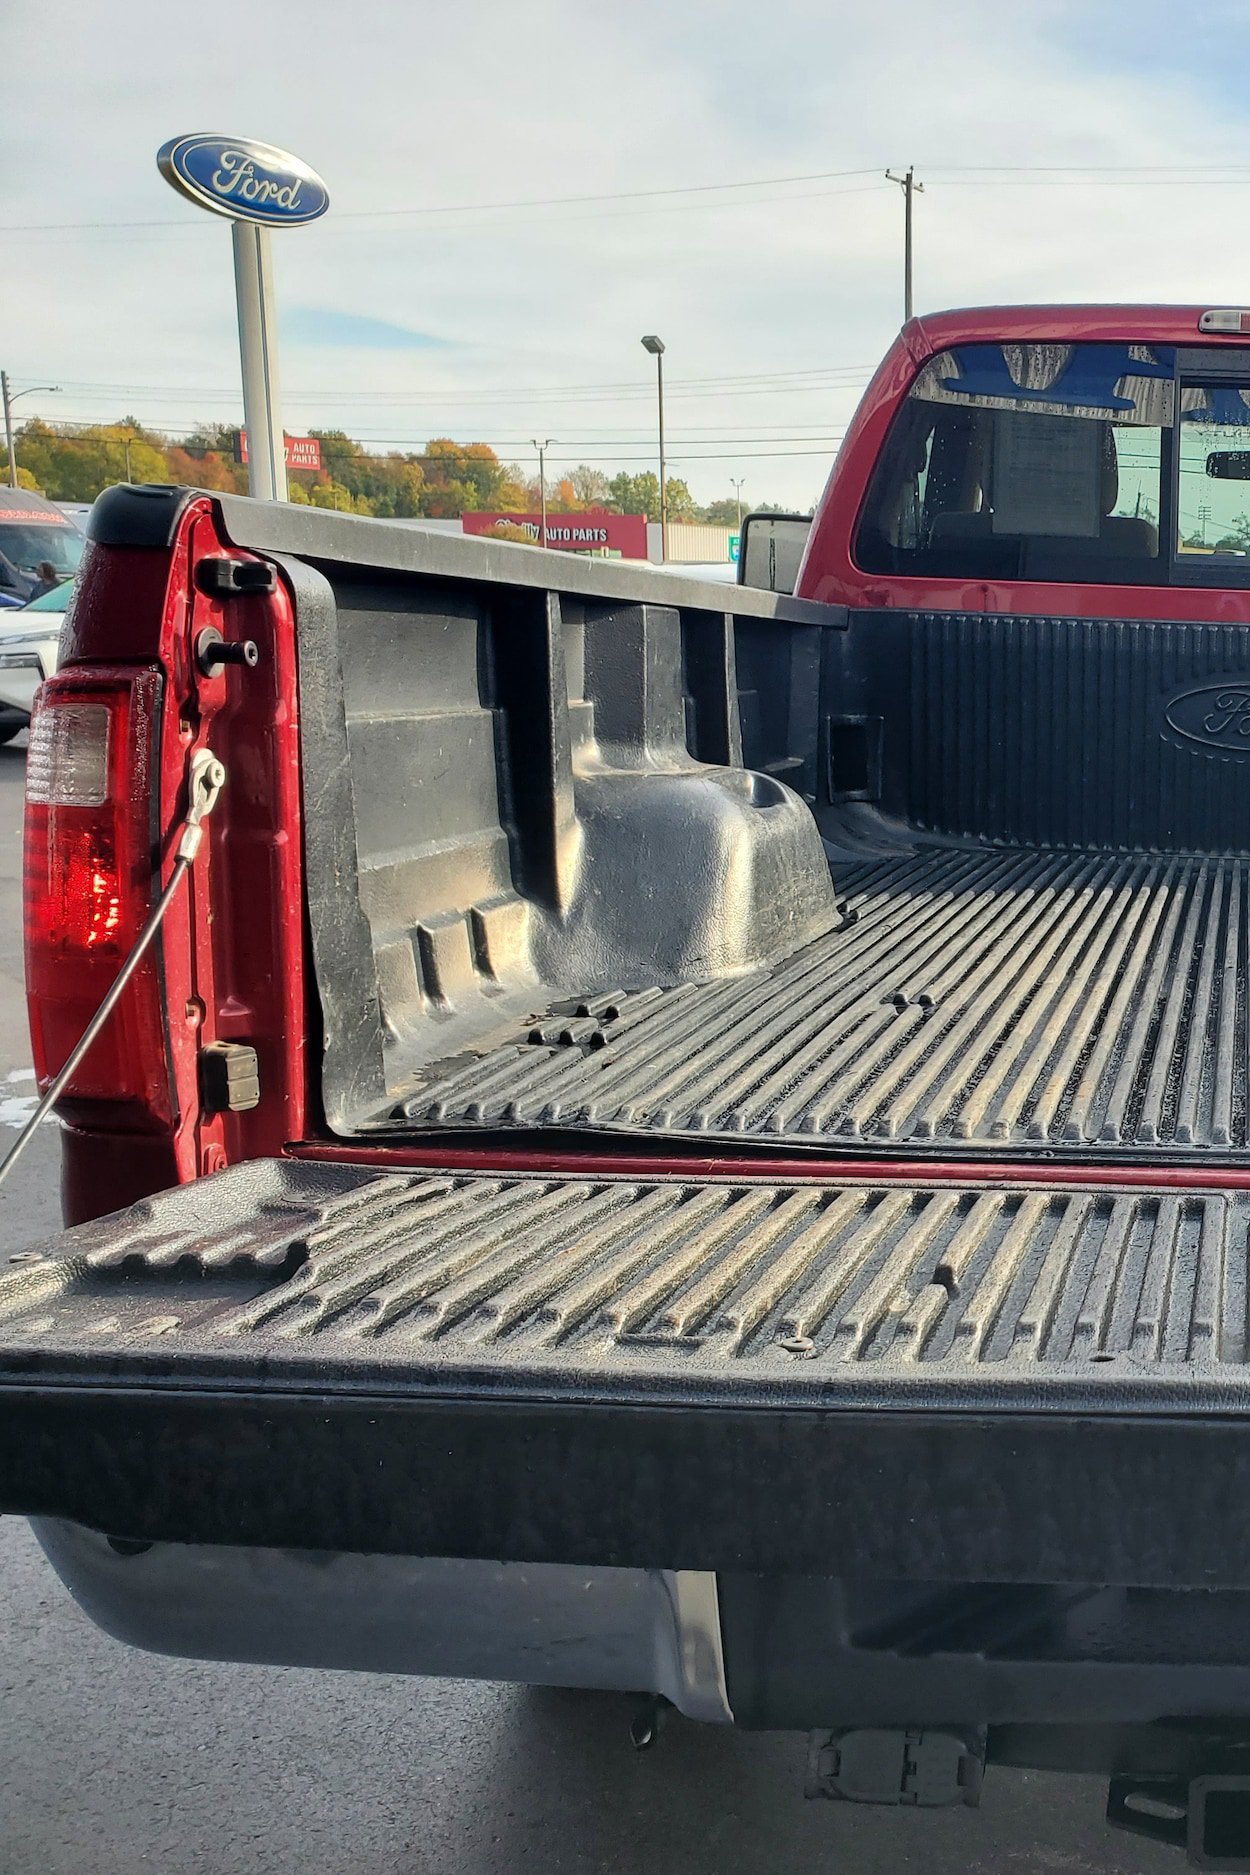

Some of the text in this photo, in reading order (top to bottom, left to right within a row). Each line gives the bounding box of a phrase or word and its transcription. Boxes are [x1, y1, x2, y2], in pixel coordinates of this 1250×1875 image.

[212, 150, 302, 210] Ford
[293, 442, 316, 454] AUTO
[291, 453, 318, 465] PARTS
[572, 528, 607, 542] PARTS
